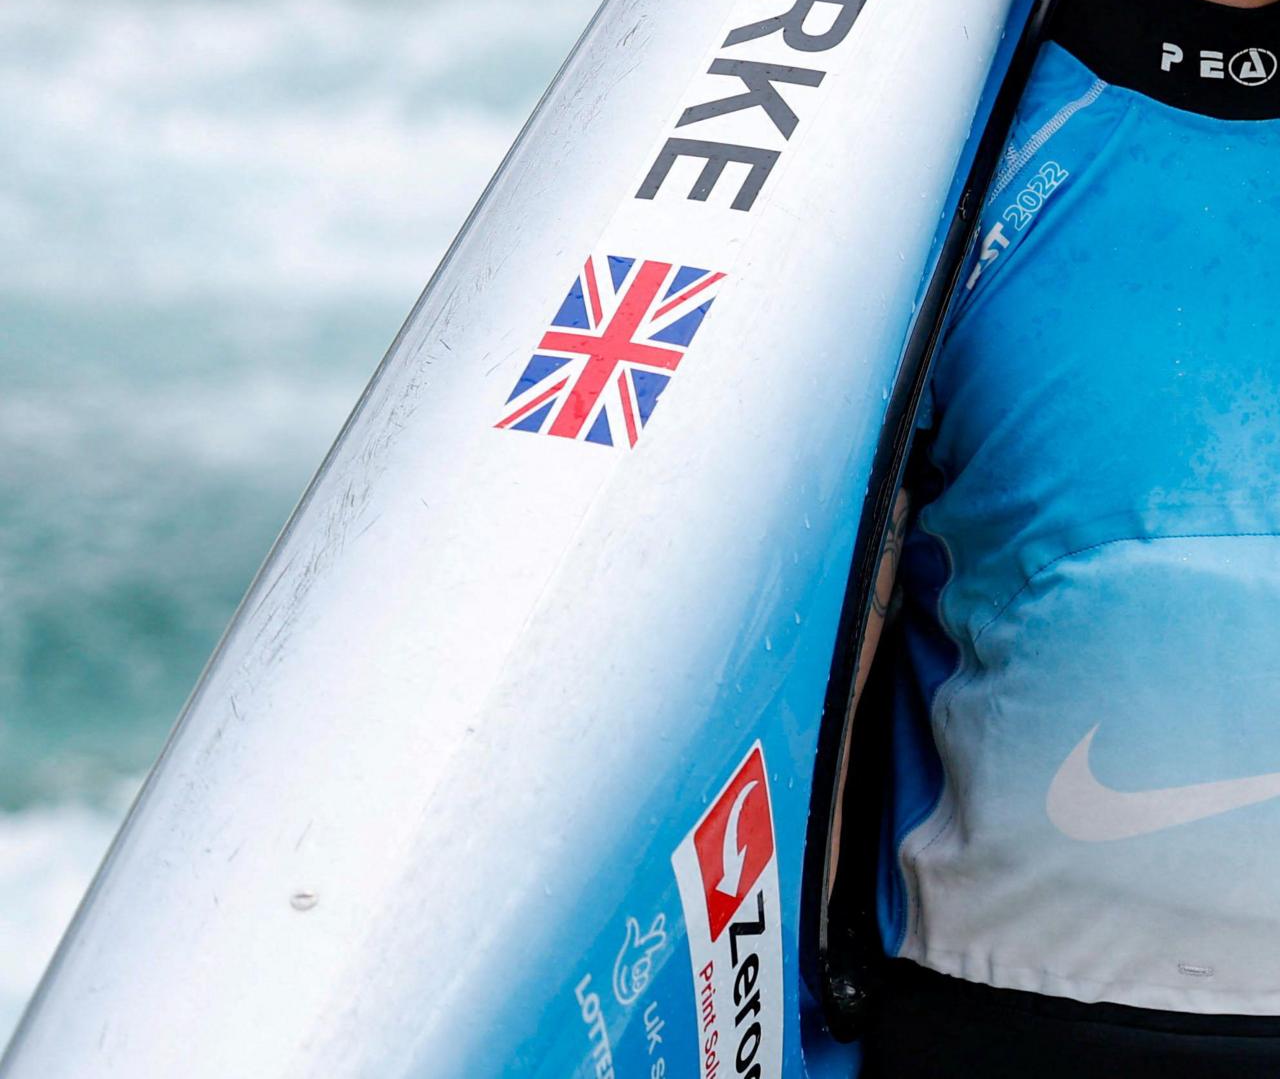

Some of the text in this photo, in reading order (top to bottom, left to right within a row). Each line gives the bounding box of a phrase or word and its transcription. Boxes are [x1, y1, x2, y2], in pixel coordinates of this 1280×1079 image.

[1003, 161, 1069, 231] 2022
[699, 960, 717, 1032] Print
[644, 1001, 666, 1079] UK S
